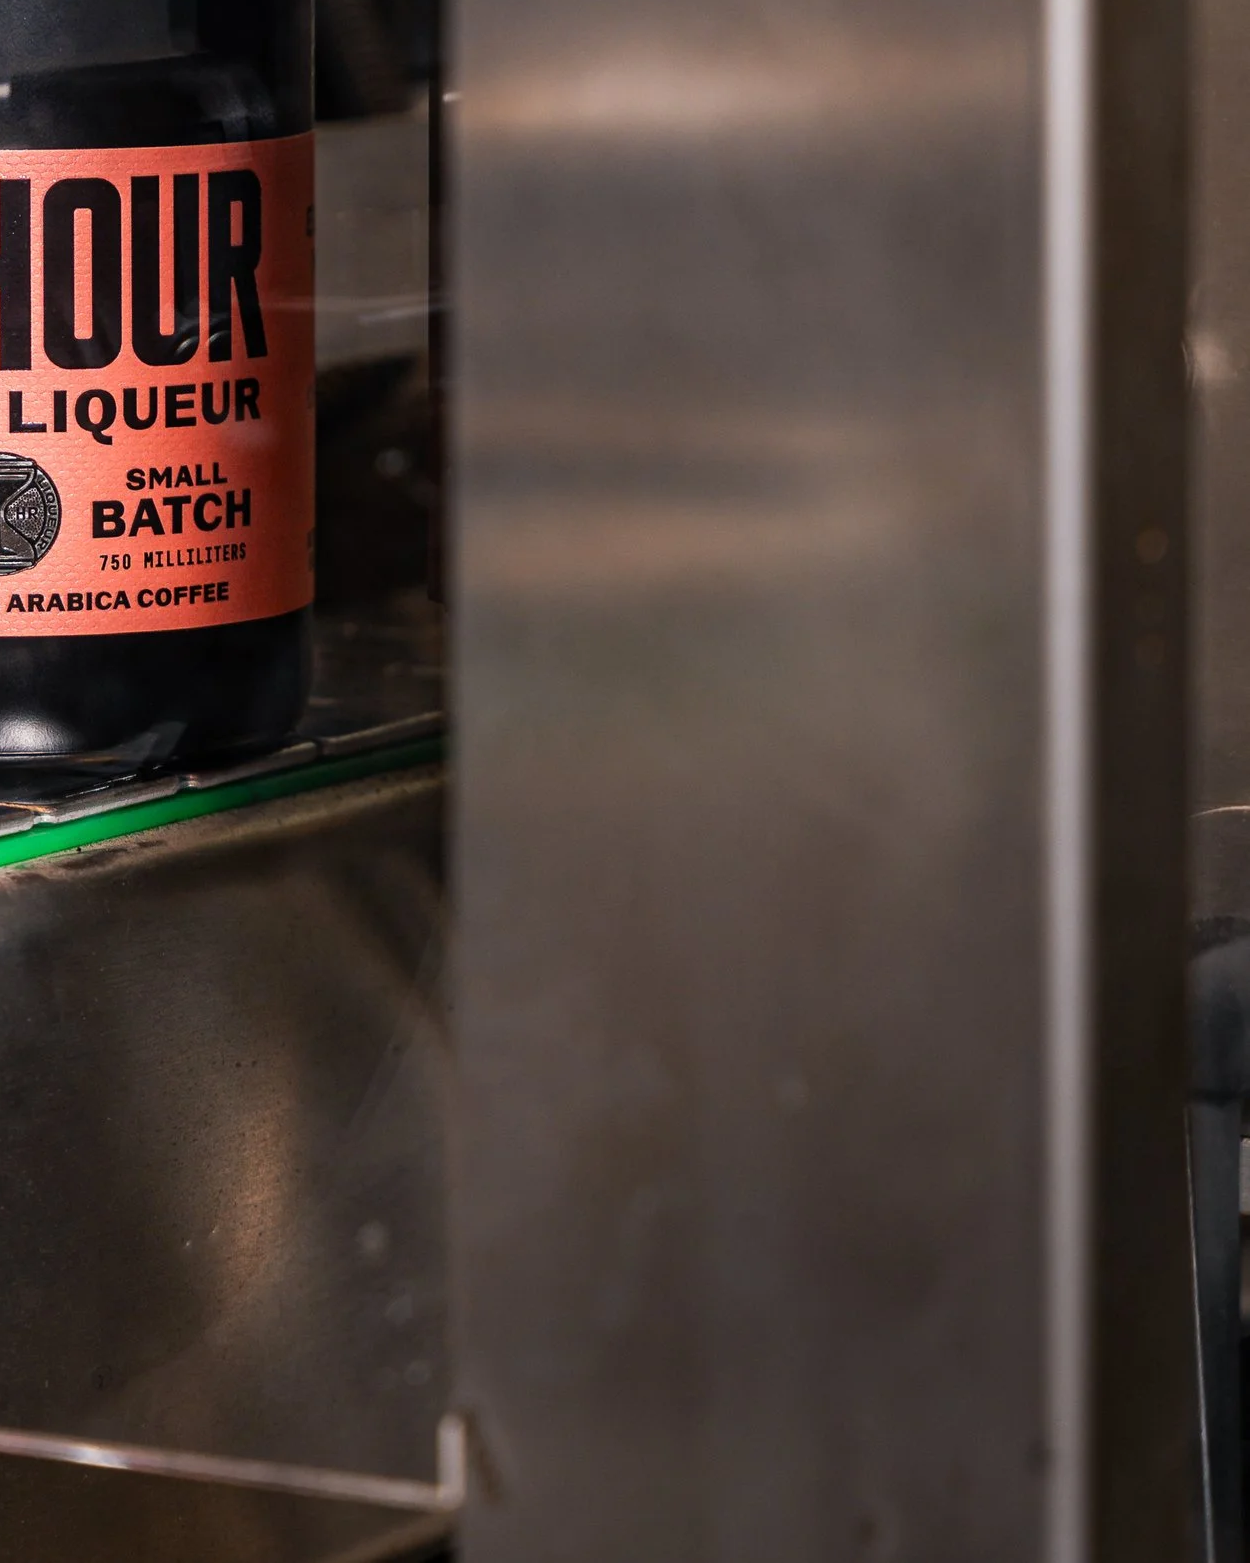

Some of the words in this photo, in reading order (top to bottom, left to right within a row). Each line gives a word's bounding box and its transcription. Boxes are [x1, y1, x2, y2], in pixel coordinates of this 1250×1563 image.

[8, 377, 260, 445] LIQUEUR
[126, 462, 228, 491] SMALL
[16, 506, 39, 520] HR
[37, 475, 57, 550] LIQUEUR
[92, 488, 251, 539] BATCH
[100, 553, 131, 571] 750
[144, 543, 246, 569] MILLILITERS
[7, 590, 131, 613] ARABICA
[137, 581, 230, 608] COFFEE
